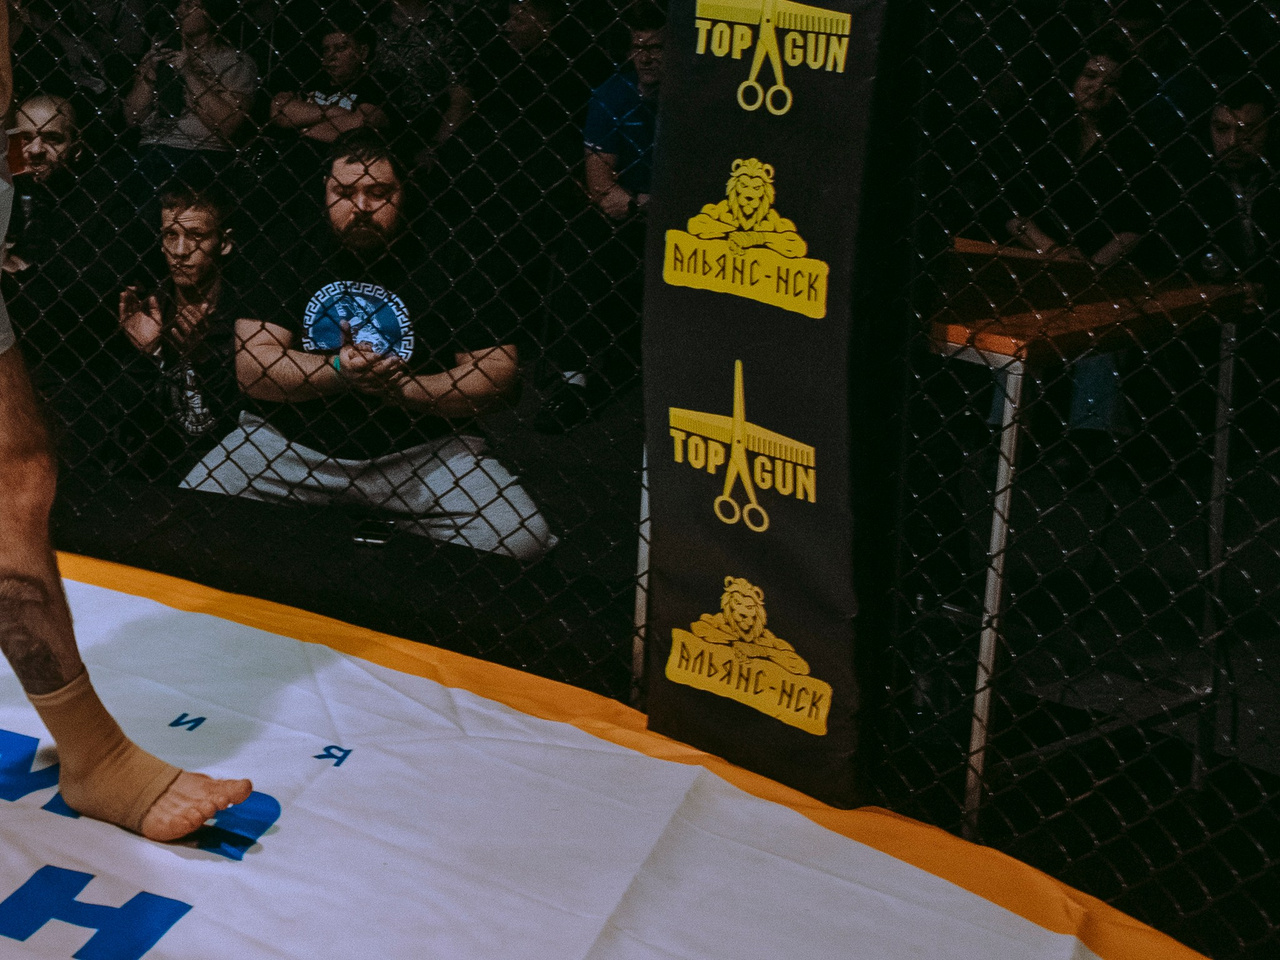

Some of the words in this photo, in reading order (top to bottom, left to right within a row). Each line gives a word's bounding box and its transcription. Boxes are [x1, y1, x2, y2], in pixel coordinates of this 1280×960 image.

[695, 19, 753, 60] TOP
[784, 31, 849, 73] GUN
[673, 243, 820, 302] АЛЬЯНС-НСК
[670, 428, 726, 475] TOP
[753, 455, 817, 504] GUN
[678, 641, 824, 720] АЛЬЯНС-НСК
